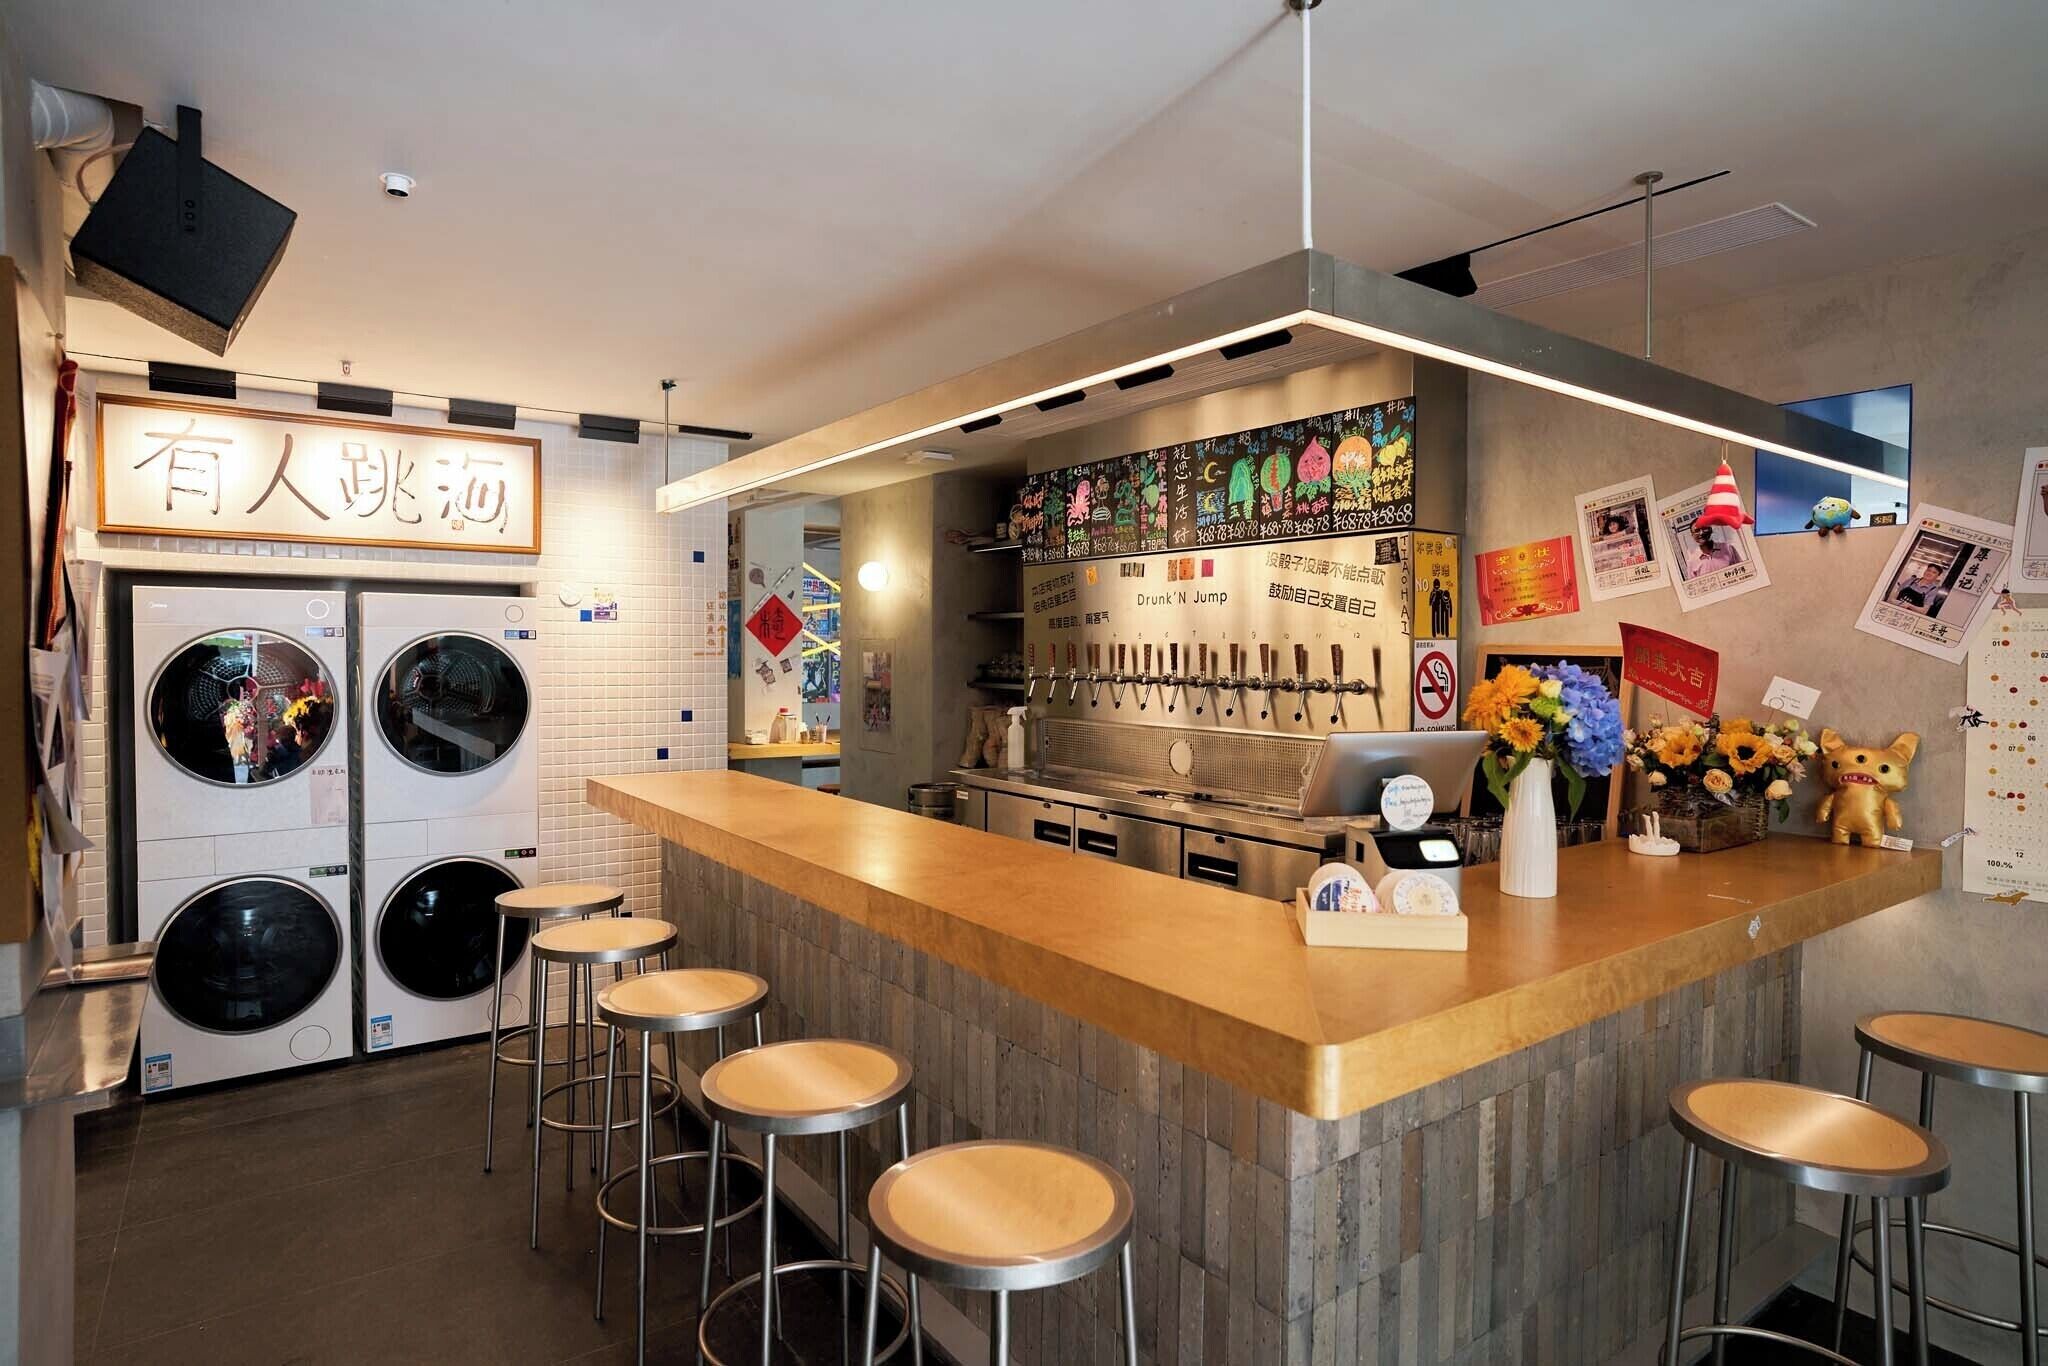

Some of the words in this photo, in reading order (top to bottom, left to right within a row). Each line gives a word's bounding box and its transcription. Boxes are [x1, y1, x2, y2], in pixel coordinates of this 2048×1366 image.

[134, 418, 509, 533] 有人跳海
[1266, 551, 1386, 586] 没骰子没牌不能点歌
[1193, 590, 1228, 607] Jump
[1268, 582, 1377, 618] 鼓励自己安置自己
